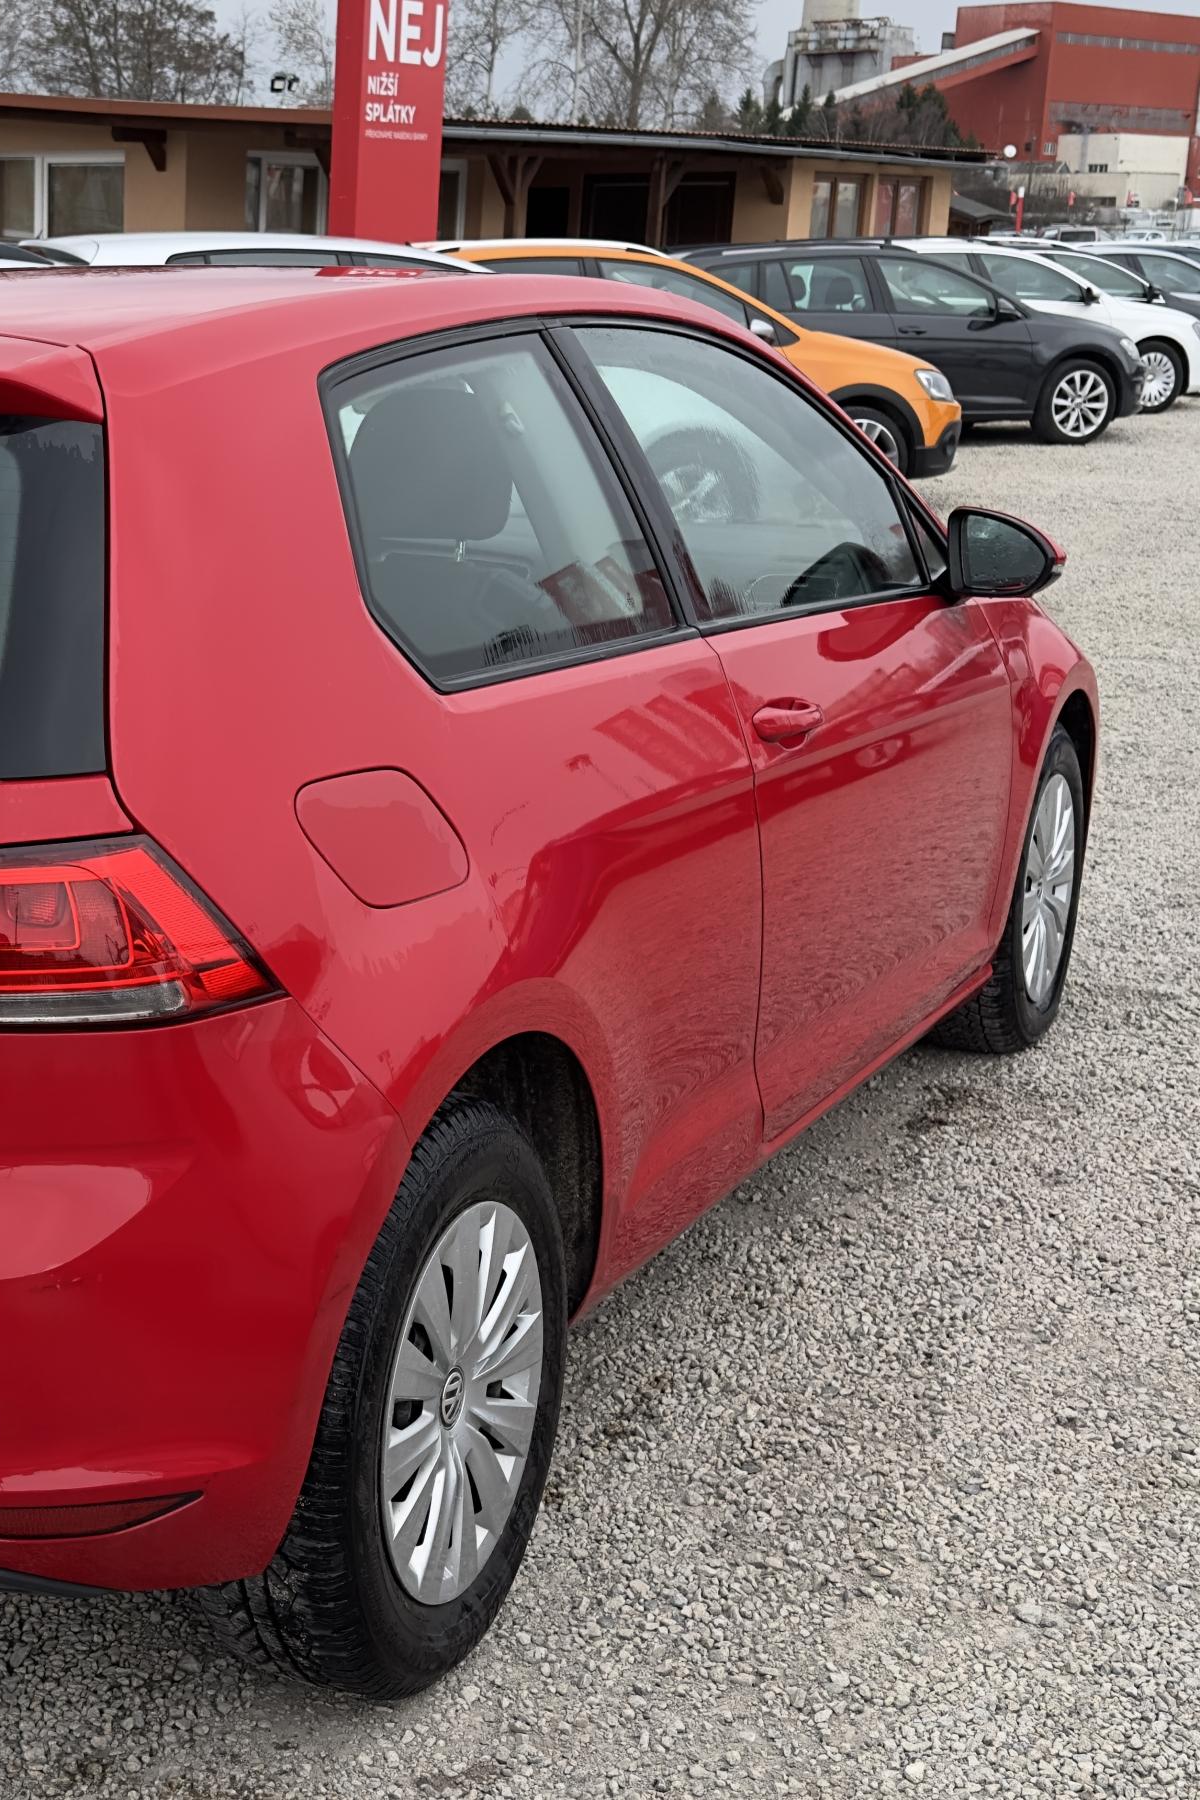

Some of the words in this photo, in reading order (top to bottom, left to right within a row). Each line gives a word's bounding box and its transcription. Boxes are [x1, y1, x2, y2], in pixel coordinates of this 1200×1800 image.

[368, 0, 444, 68] NEJ
[367, 72, 399, 96] NIŽŠÍ
[365, 100, 416, 125] SPLÁTKY
